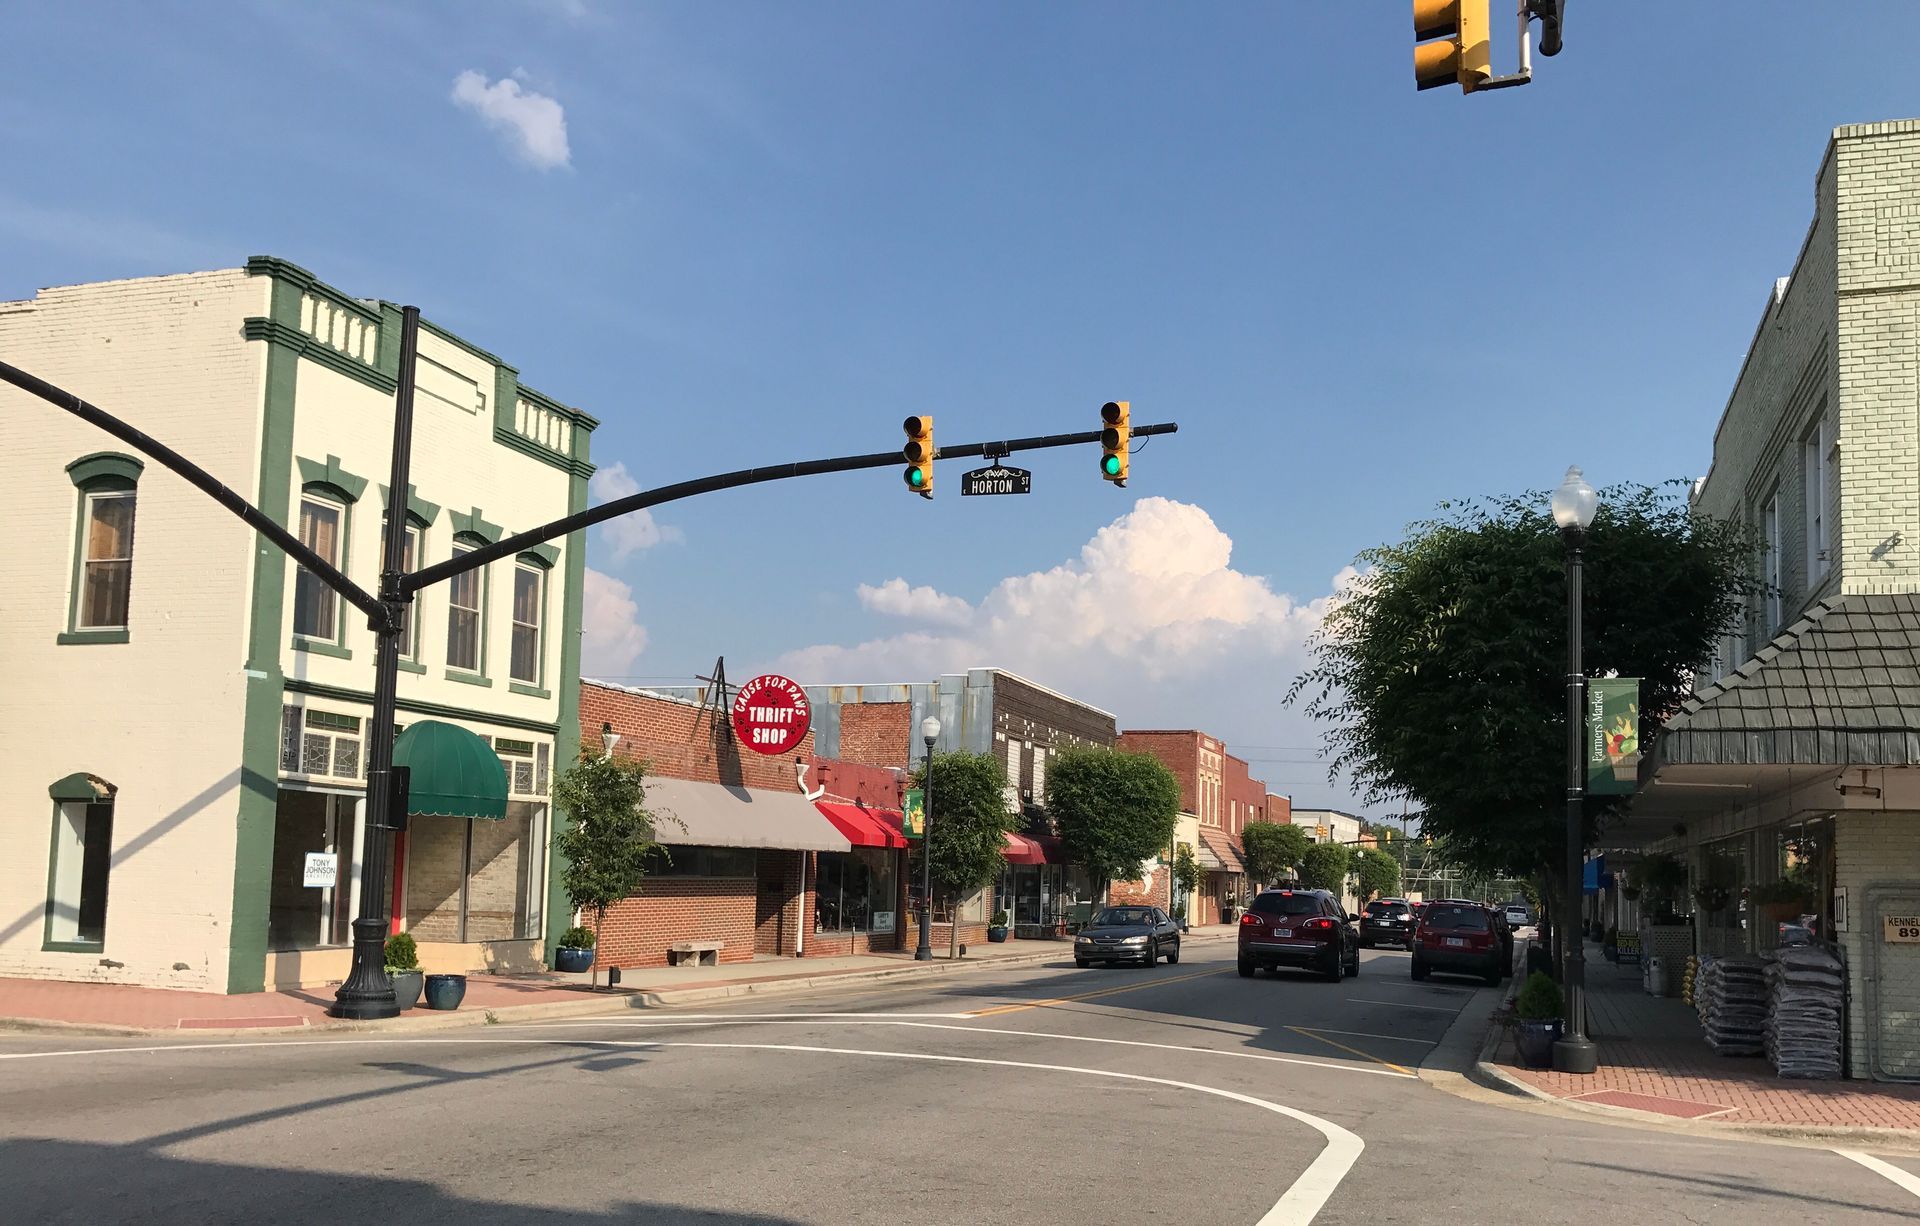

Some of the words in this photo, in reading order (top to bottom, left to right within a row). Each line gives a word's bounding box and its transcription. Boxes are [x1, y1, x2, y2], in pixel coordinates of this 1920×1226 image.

[972, 480, 1013, 494] HORTON
[1021, 477, 1029, 485] ST
[735, 679, 762, 713] CAUSE
[764, 676, 787, 690] FOR
[786, 685, 806, 717] PAWS
[749, 706, 794, 723] THRIFT
[1591, 690, 1603, 722] Market
[752, 727, 787, 744] SHOP
[1592, 724, 1603, 762] Farmers
[305, 866, 335, 874] JOHNSON
[312, 858, 330, 867] TONY
[1888, 917, 1920, 927] KENNEL
[1899, 928, 1920, 938] 89
